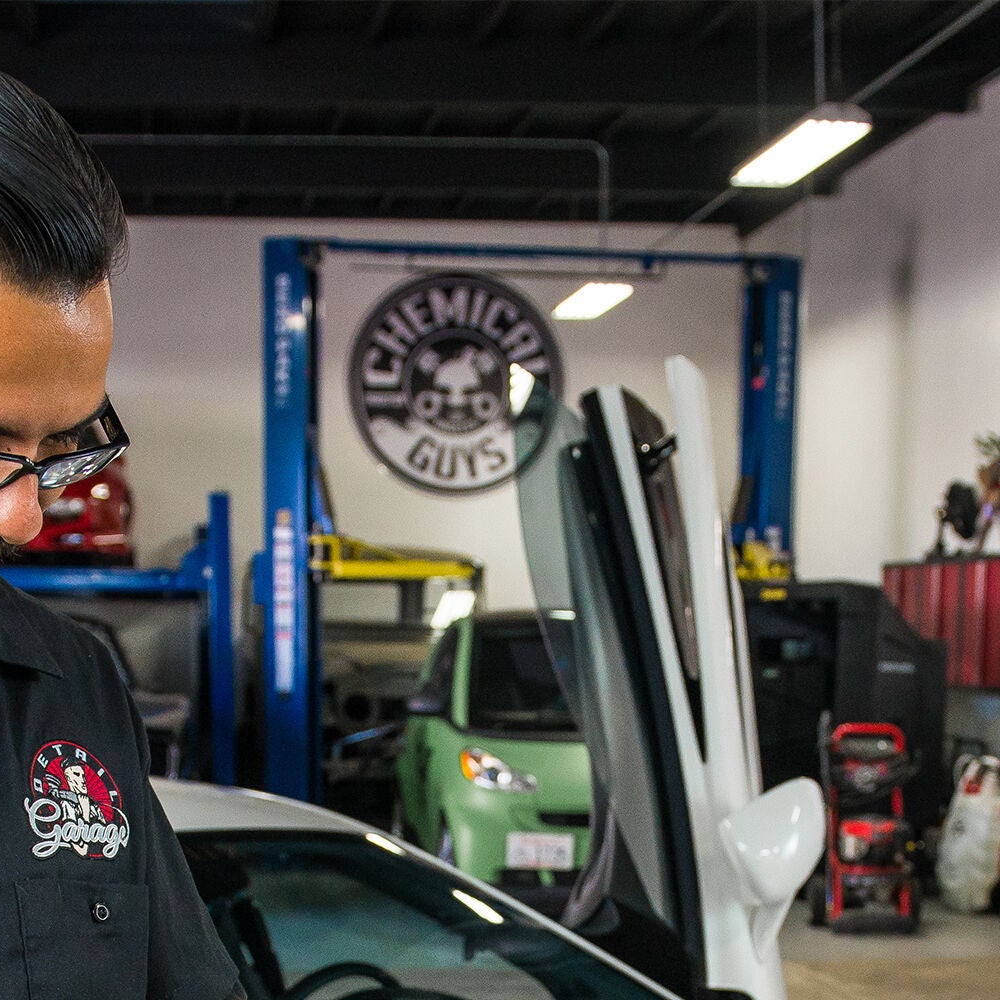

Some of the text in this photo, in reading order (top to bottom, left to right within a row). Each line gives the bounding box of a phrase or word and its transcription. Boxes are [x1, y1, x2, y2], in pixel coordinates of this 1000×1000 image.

[407, 435, 506, 480] GUYS
[33, 744, 119, 802] DETAIL
[24, 797, 130, 858] Garage
